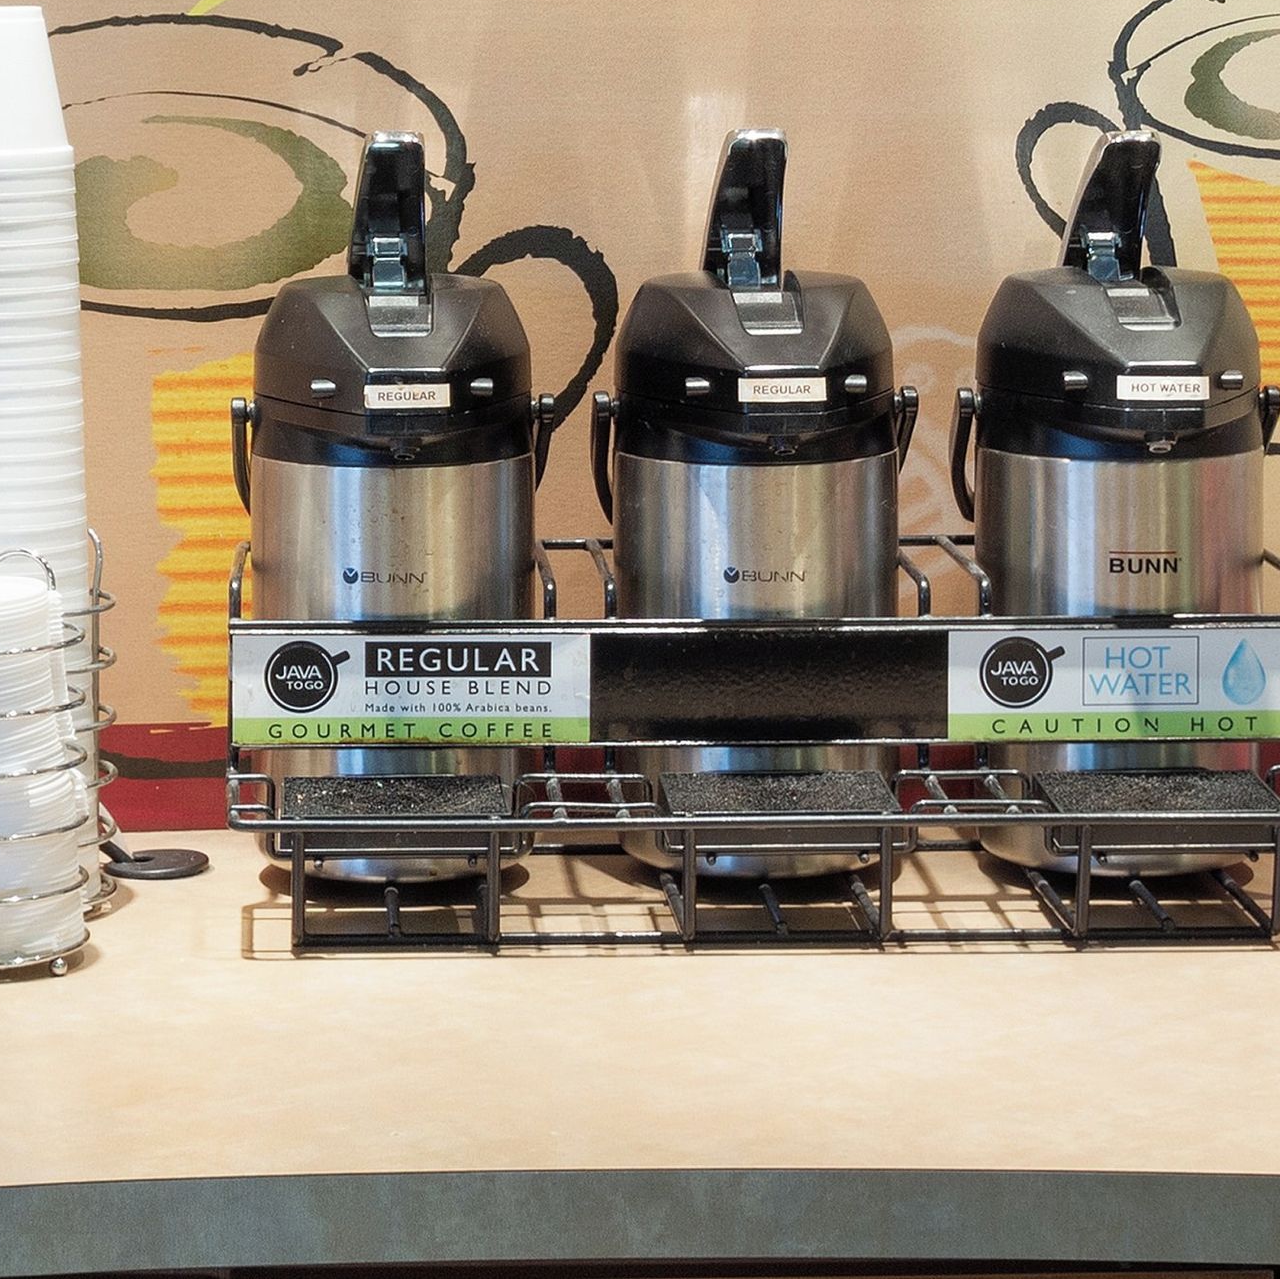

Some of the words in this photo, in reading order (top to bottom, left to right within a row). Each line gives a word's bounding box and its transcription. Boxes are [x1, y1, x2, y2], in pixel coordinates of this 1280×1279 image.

[753, 385, 811, 395] REGULAR
[1131, 383, 1156, 392] HOT
[1159, 383, 1201, 392] WATER
[377, 391, 436, 401] REGULAR
[1109, 557, 1178, 574] BUNN
[361, 571, 426, 583] BUNN
[742, 570, 805, 582] BUNN
[376, 647, 540, 672] REGULAR
[1105, 646, 1171, 670] HOT
[275, 665, 322, 680] JAVA
[990, 661, 1037, 675] JAVA
[365, 680, 451, 695] HOUSE
[468, 680, 552, 695] BLEND
[1089, 673, 1192, 696] WATER
[365, 703, 395, 713] Made
[401, 703, 426, 712] with
[432, 703, 461, 712] 100%
[466, 703, 510, 712] Arabica
[515, 703, 552, 713] beans.
[268, 723, 416, 739] GOURMET
[439, 723, 552, 738] COFFEE
[991, 717, 1160, 735] CAUTION
[1191, 716, 1258, 732] HOT
